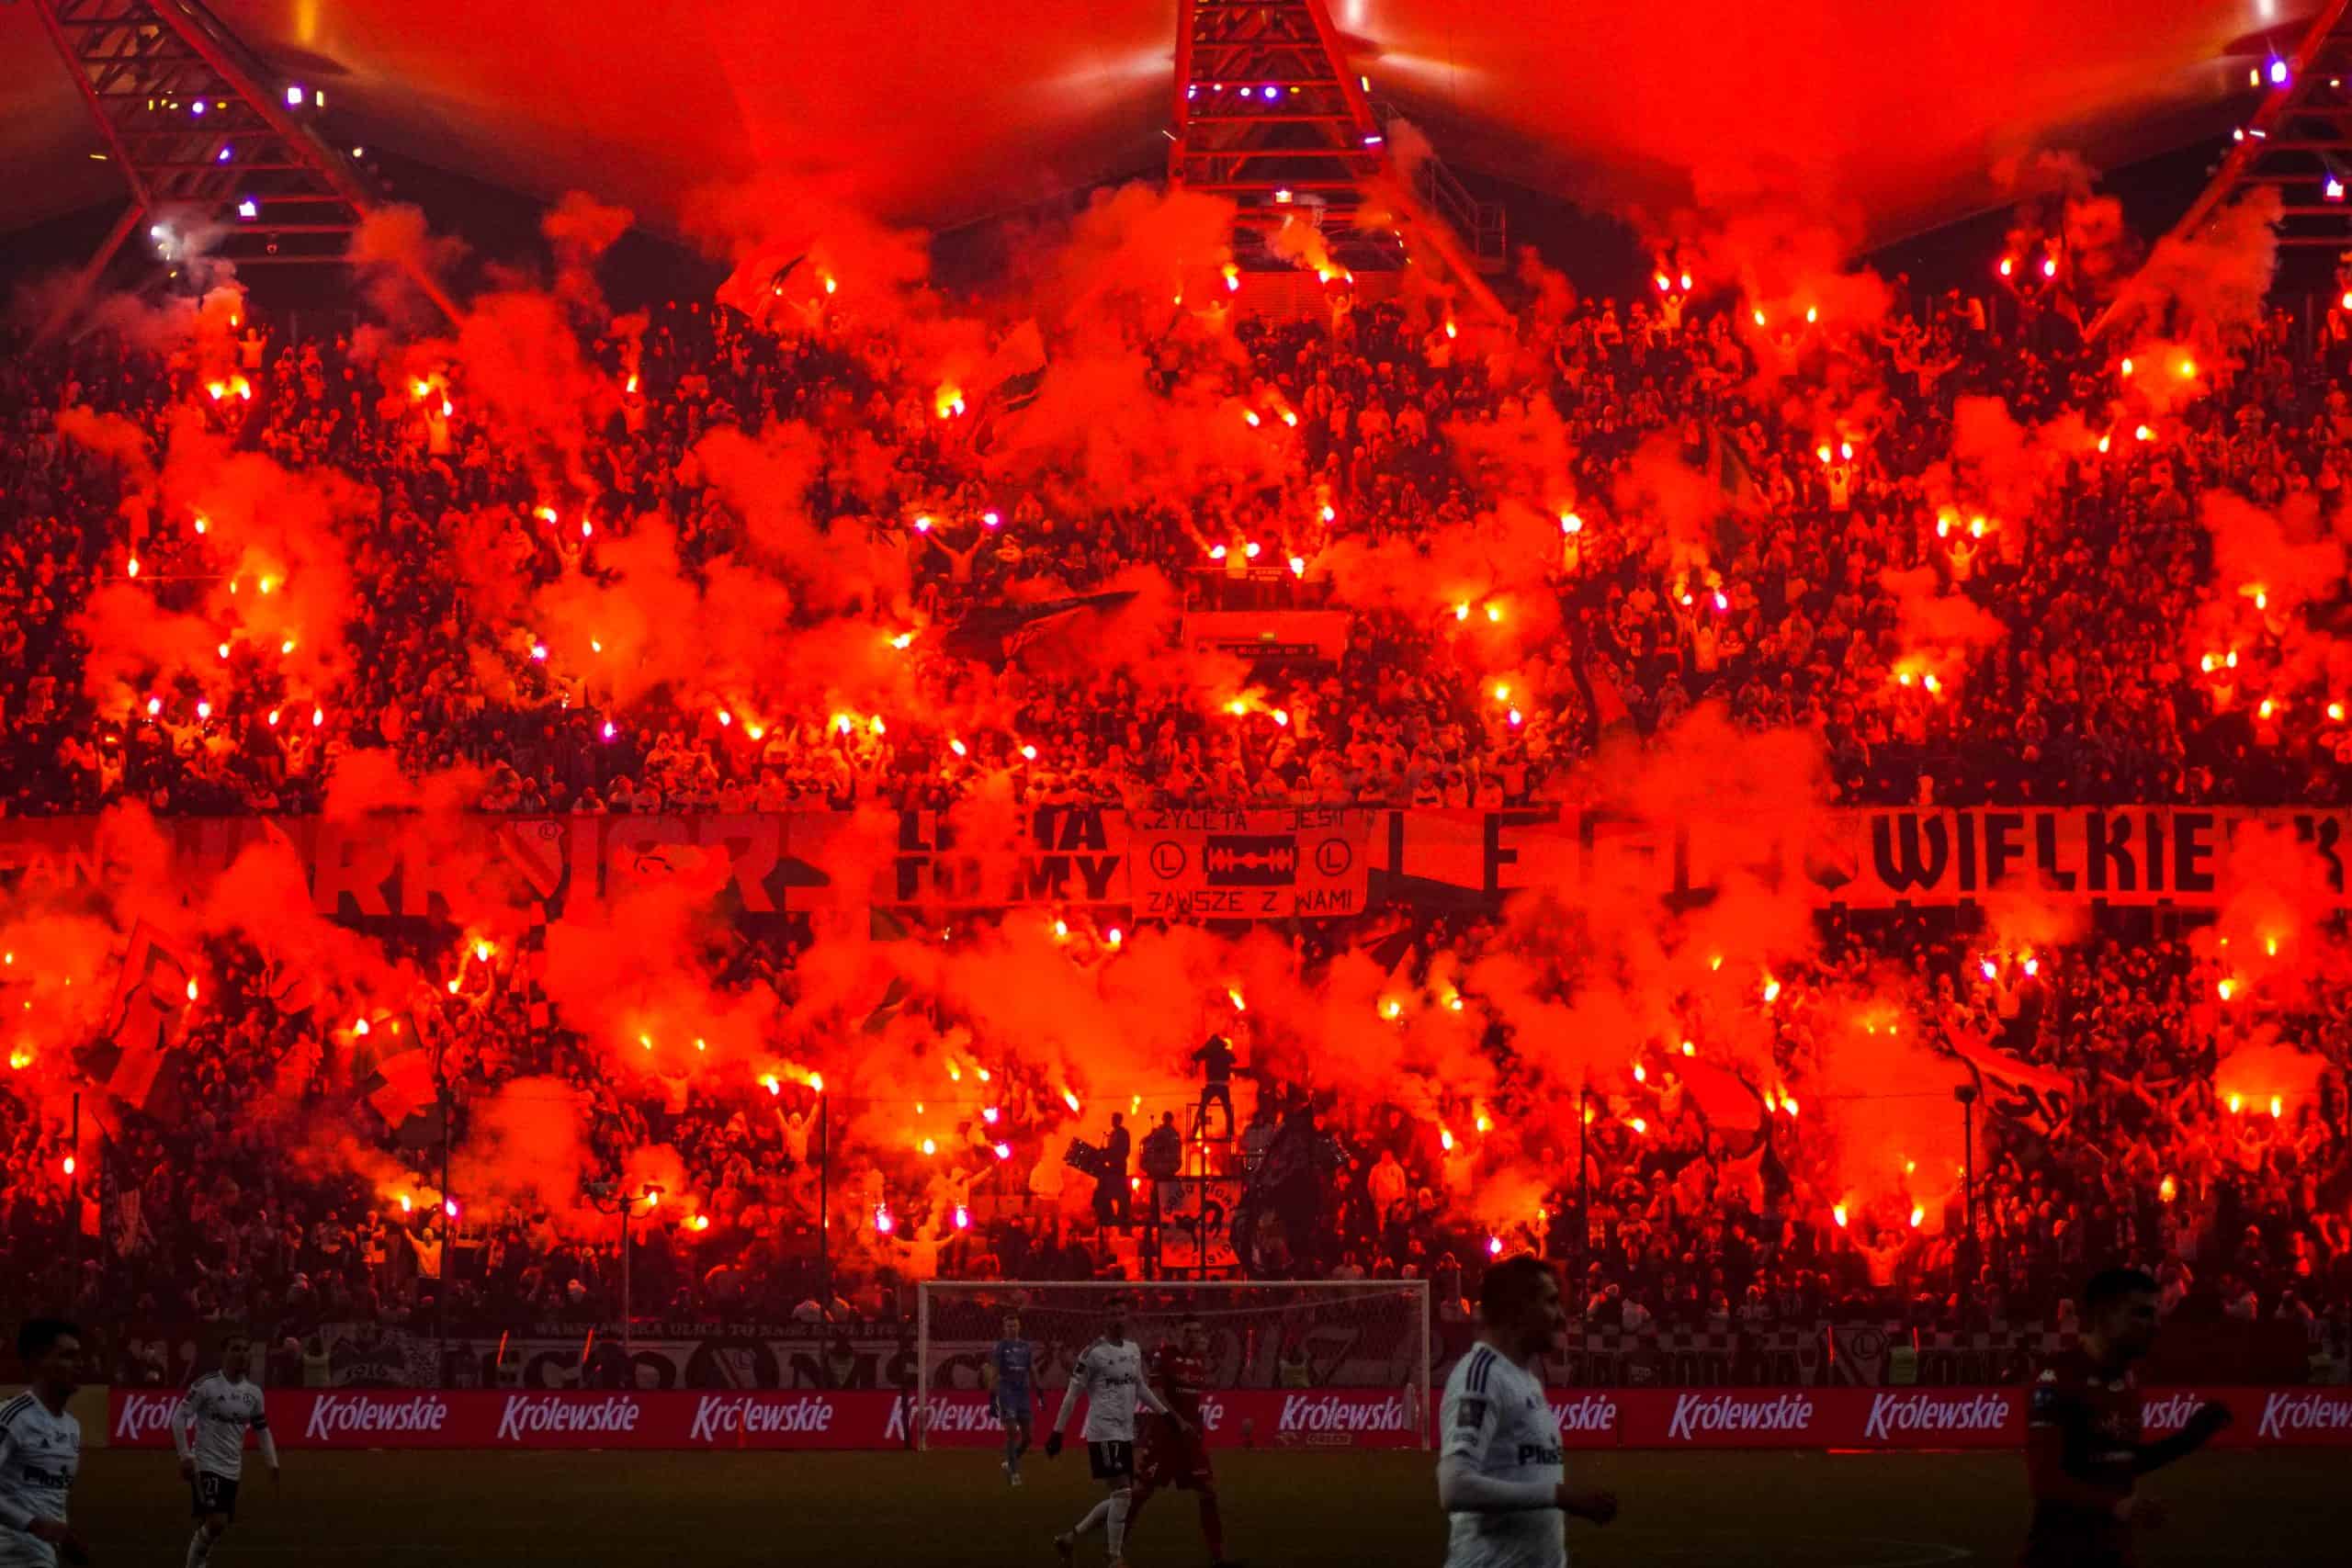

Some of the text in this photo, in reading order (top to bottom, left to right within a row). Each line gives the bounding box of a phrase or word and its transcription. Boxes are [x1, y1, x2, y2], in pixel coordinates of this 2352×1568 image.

[1871, 813, 2215, 893] WIELKIE
[1009, 855, 1120, 900] MY
[1147, 888, 1353, 913] ZAWSZE Z WAMI
[306, 1394, 447, 1440] Królewskie
[497, 1394, 639, 1441] Królewskie
[690, 1395, 832, 1441] Królewskie
[1668, 1393, 1813, 1439] Królewskie
[1864, 1393, 2009, 1439] Królewskie
[204, 1477, 220, 1495] 27
